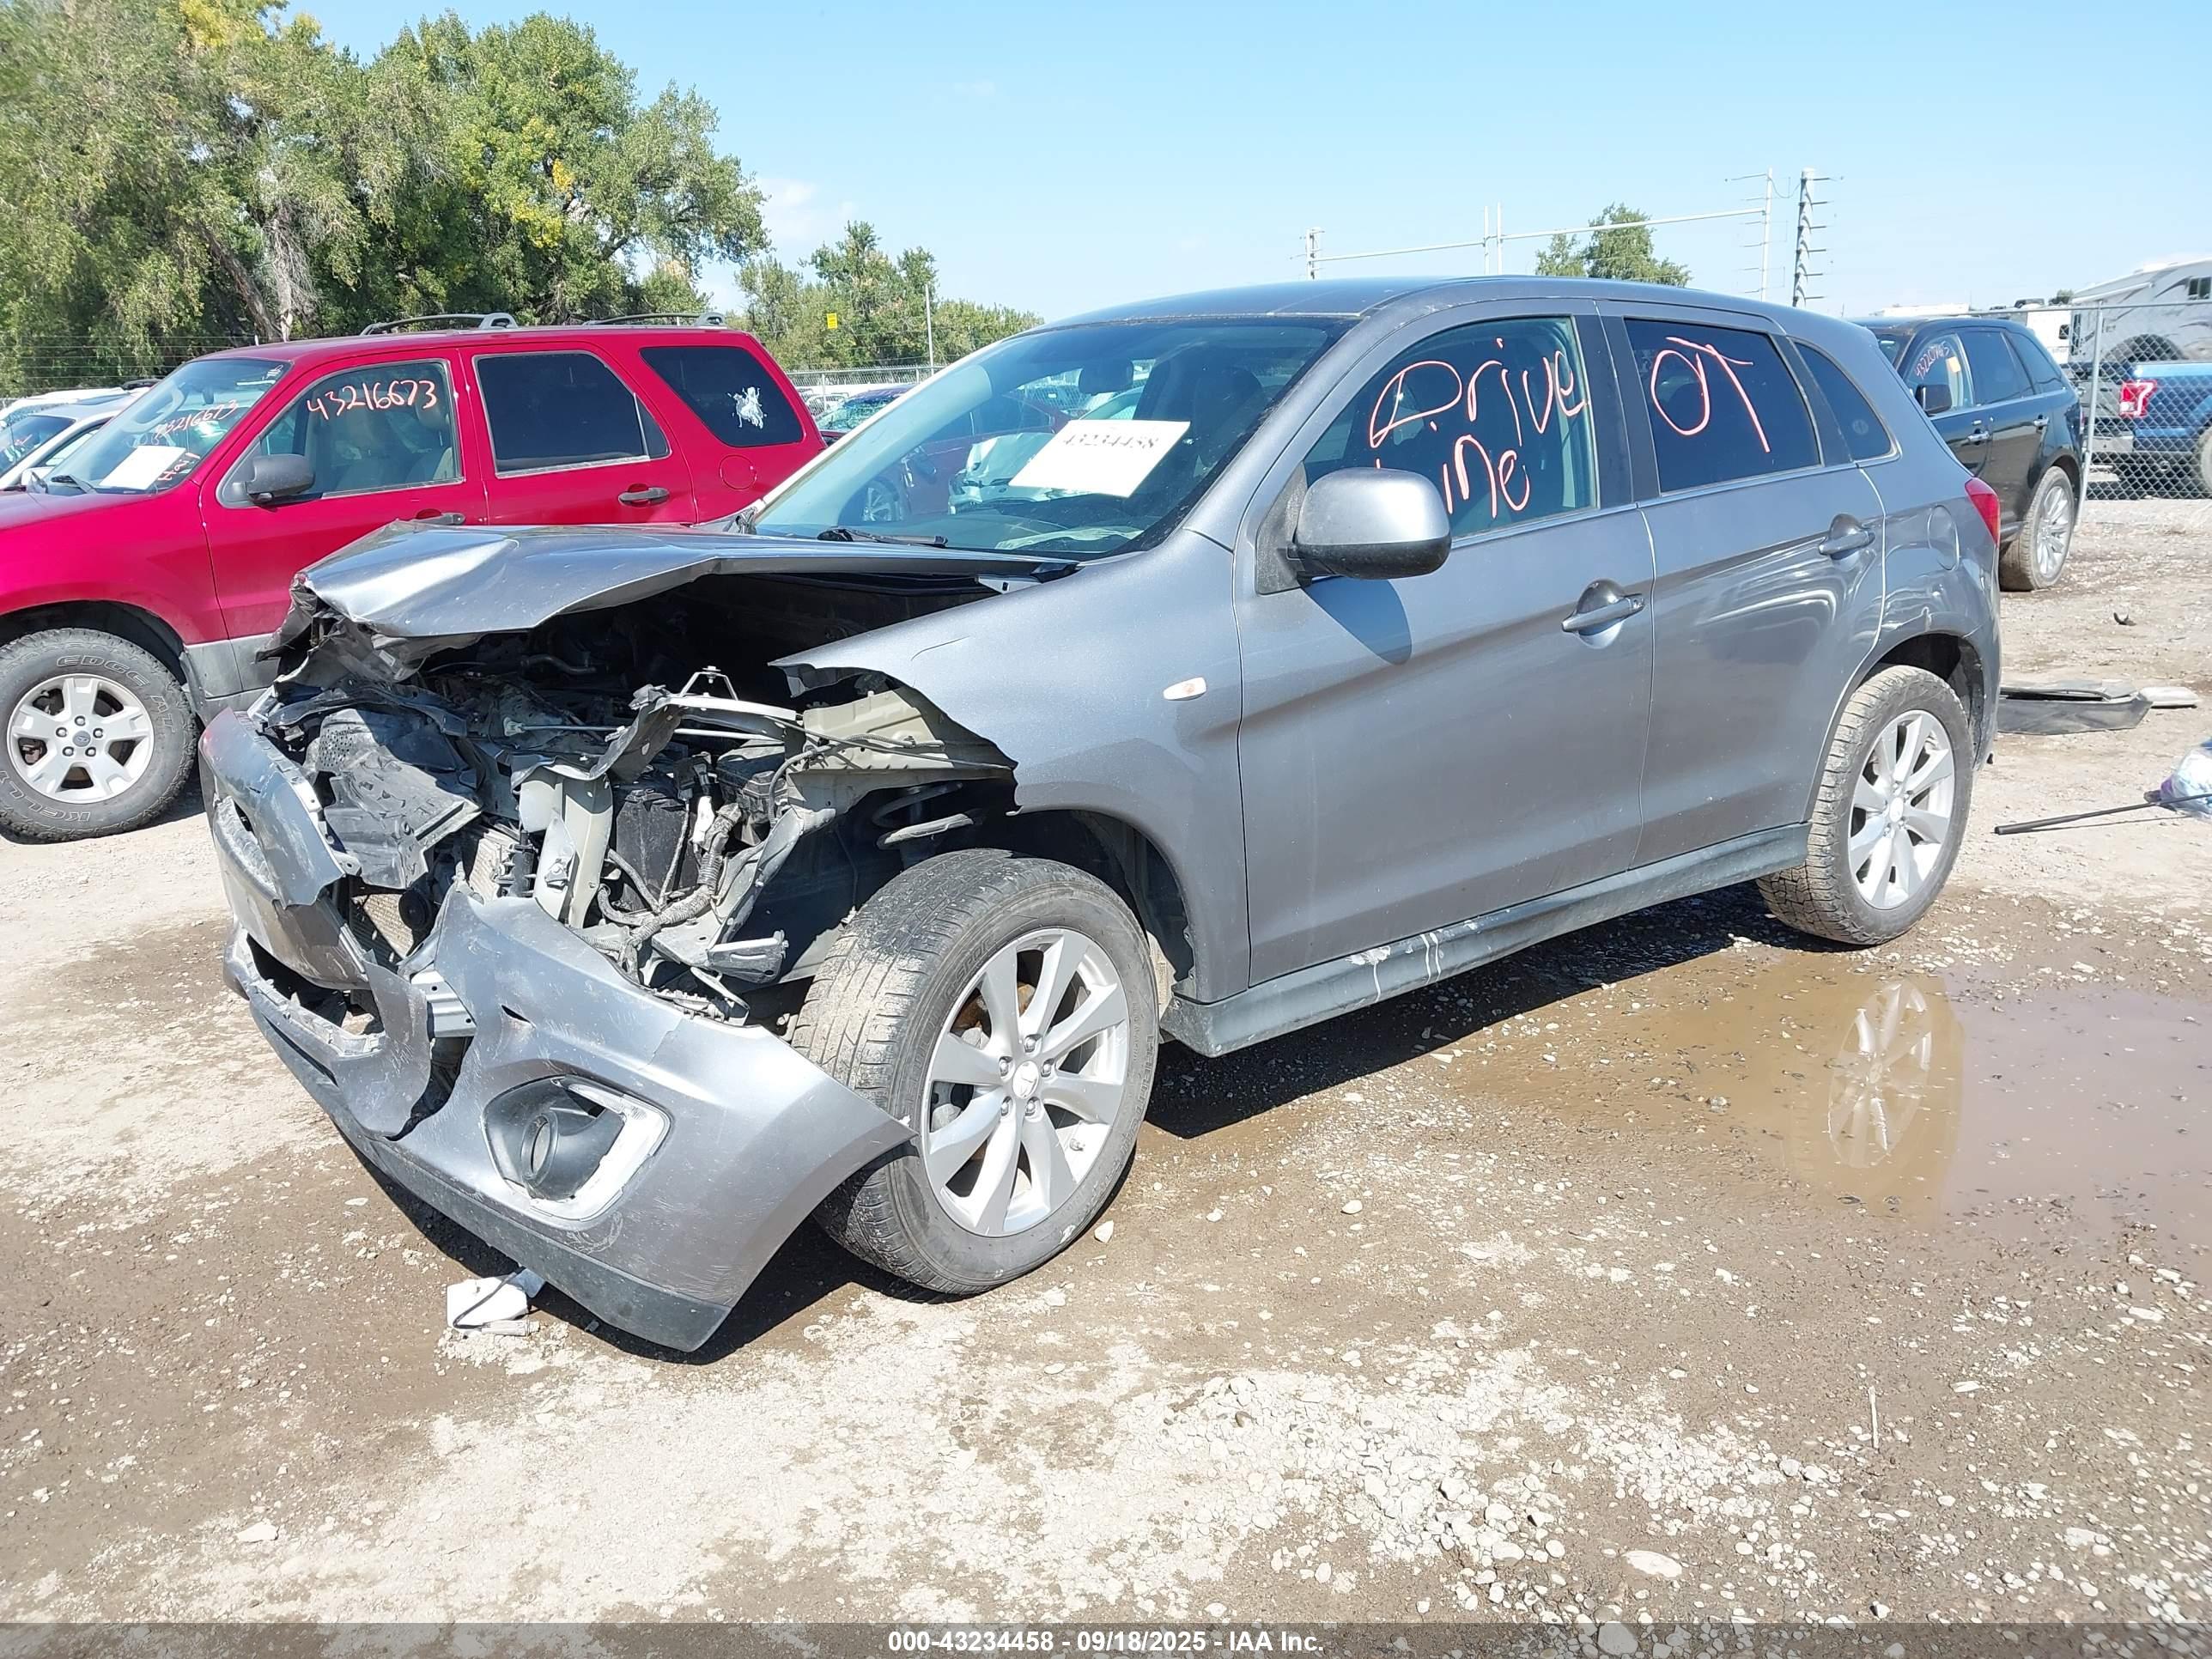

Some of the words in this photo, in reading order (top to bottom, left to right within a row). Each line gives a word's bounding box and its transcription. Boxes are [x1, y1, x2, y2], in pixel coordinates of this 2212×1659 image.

[307, 380, 438, 421] 43216673
[1369, 337, 1587, 448] Drive
[57, 654, 151, 687] EDGE
